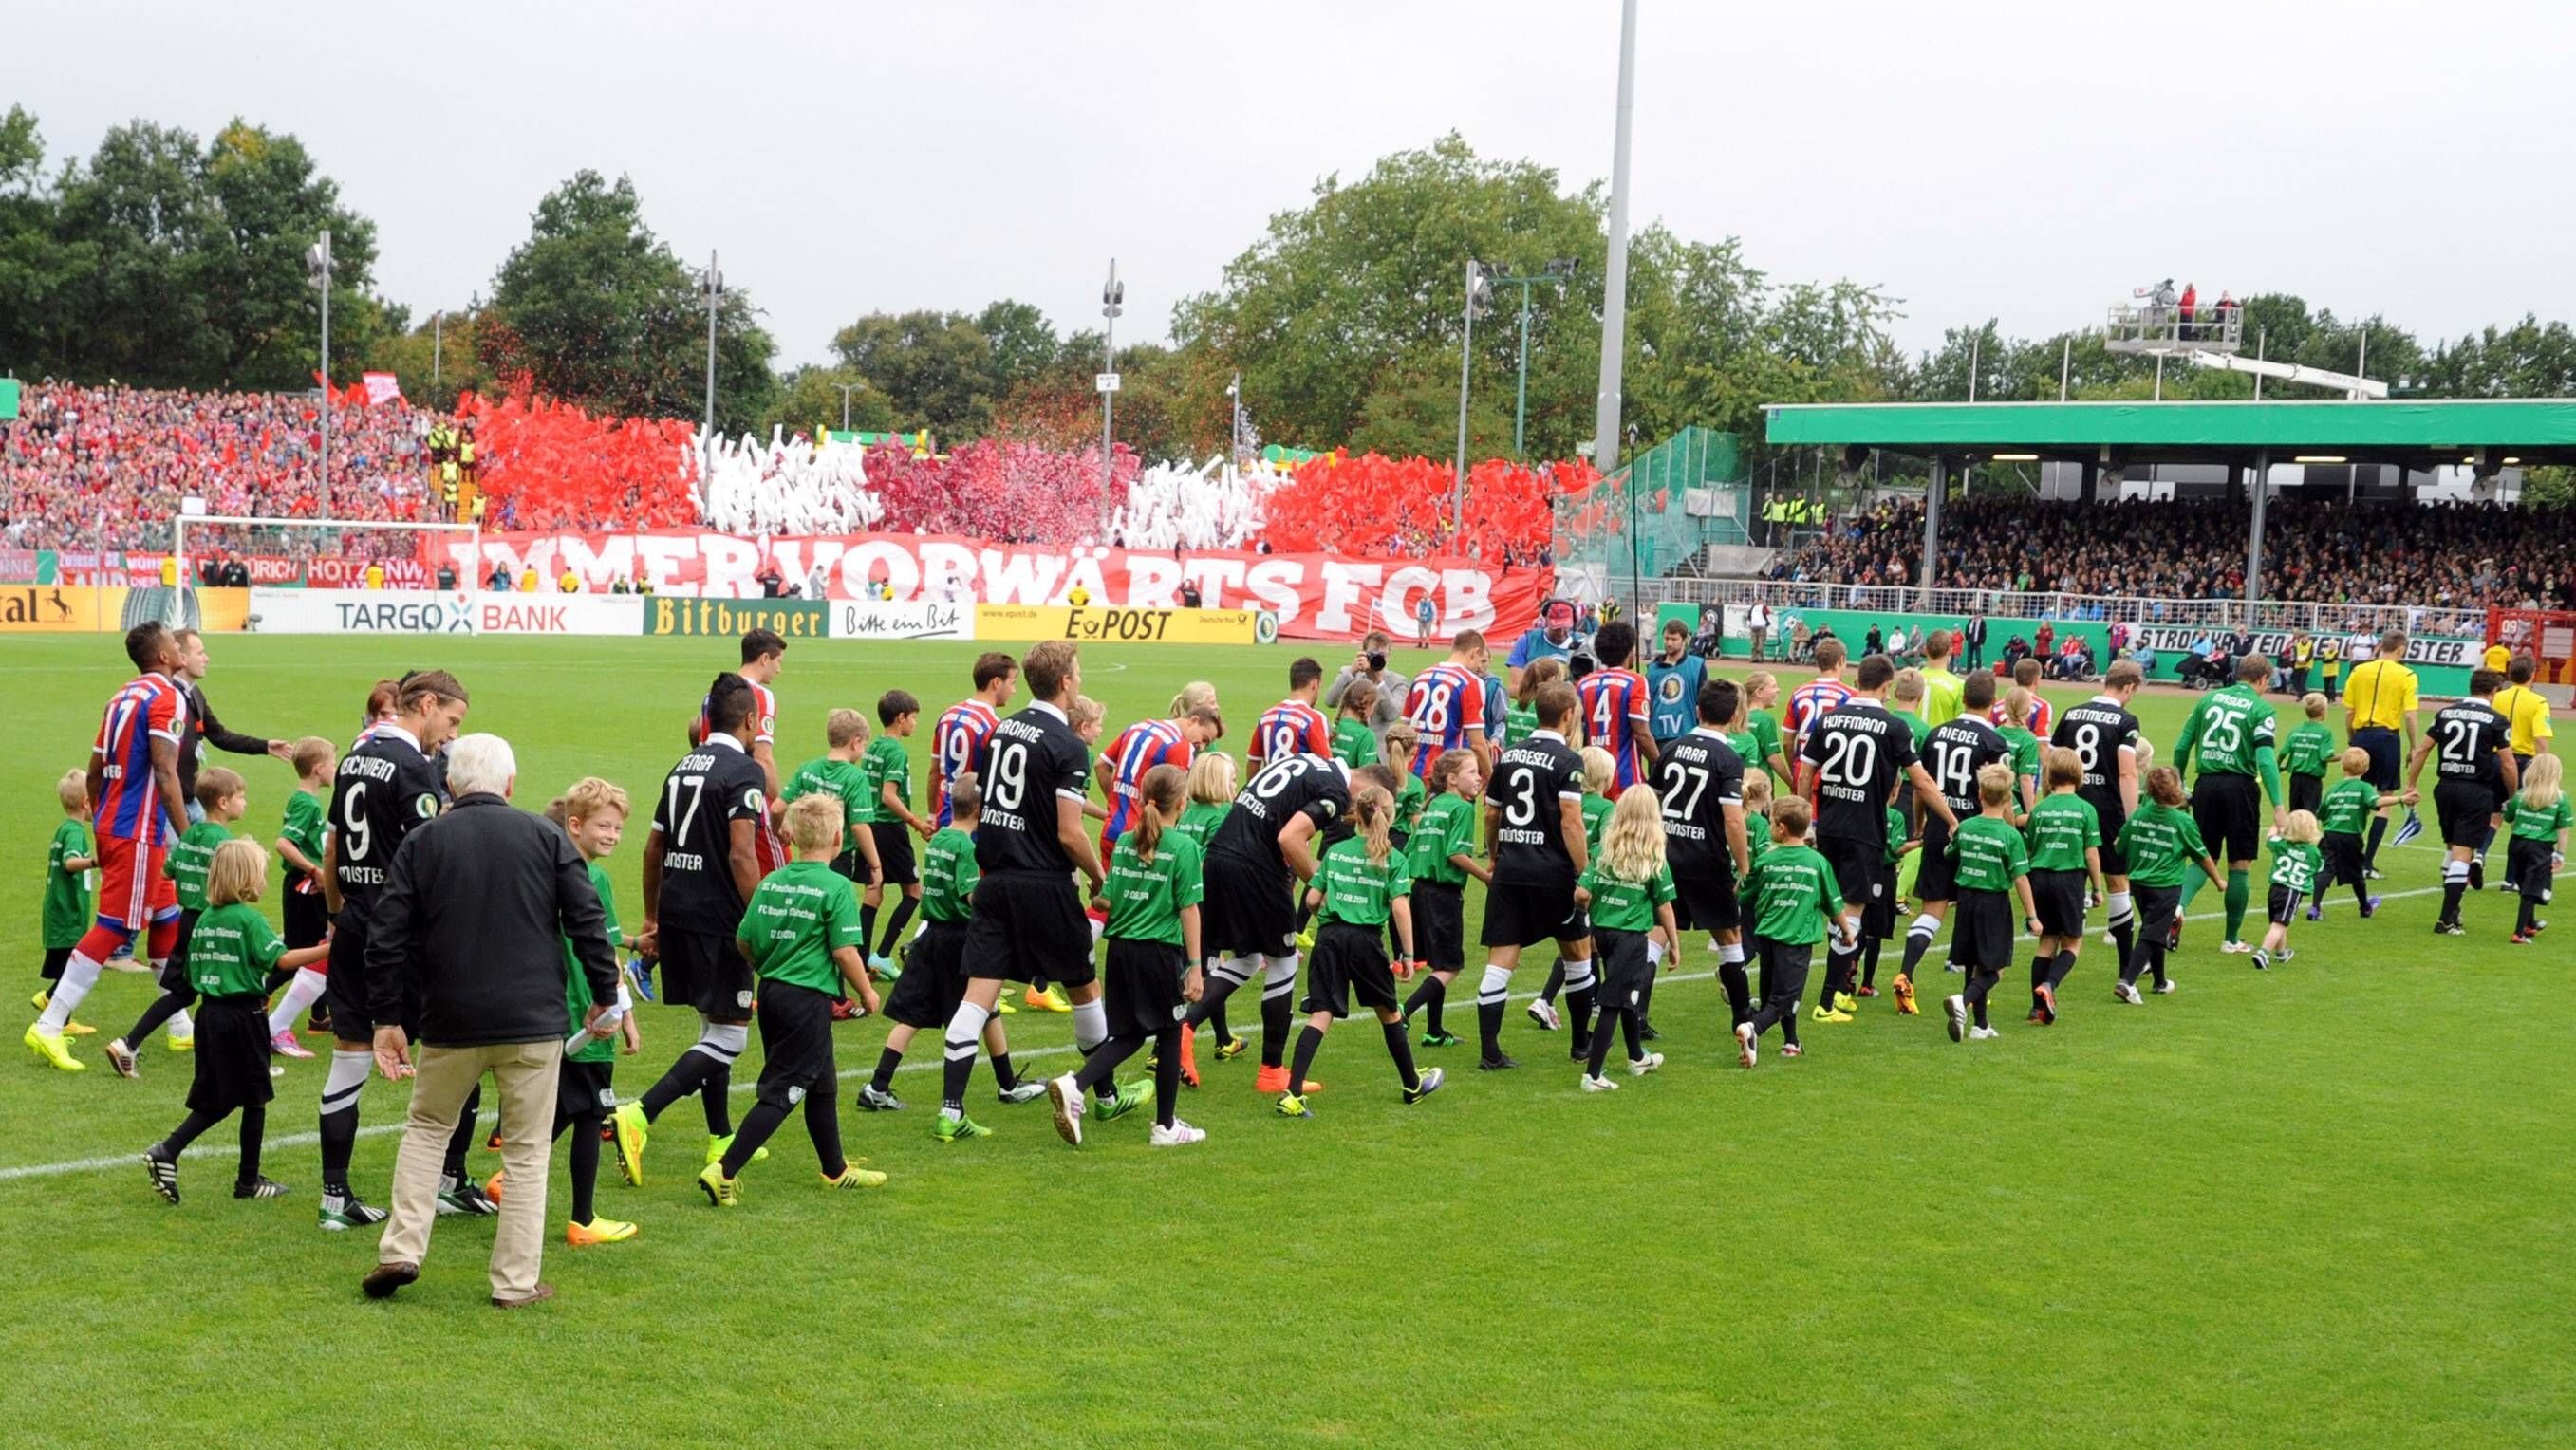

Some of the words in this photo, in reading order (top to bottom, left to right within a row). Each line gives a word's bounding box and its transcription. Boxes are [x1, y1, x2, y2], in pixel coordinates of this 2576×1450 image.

[450, 533, 759, 600] IMMER
[773, 541, 1303, 628] VORWÄRTS
[1316, 561, 1497, 638] FCB
[336, 604, 443, 630] TARGO
[483, 605, 568, 630] BANK
[656, 598, 821, 636] Bitburger
[846, 606, 886, 635] Bitte
[892, 613, 922, 630] ein
[926, 604, 960, 627] Bit
[1410, 681, 1450, 732] 28
[1593, 688, 1612, 734] 4
[1659, 713, 1683, 734] TV
[1823, 714, 1887, 734] HOFFMANN
[2065, 709, 2121, 725] HEITMEIER
[996, 718, 1044, 744] KROHNE
[1263, 725, 1294, 766] 18
[1938, 725, 1979, 746] RIEDEL
[2075, 723, 2100, 771] 8
[2202, 705, 2247, 753] 25
[2443, 719, 2479, 761] 21
[940, 723, 969, 781] 19
[985, 738, 1027, 810] 19
[1117, 729, 1154, 782] 11
[1675, 745, 1708, 763] KARA
[1821, 731, 1876, 787] 20
[1933, 740, 1972, 796] 14
[668, 775, 705, 847] 17
[1506, 768, 1535, 826] 3
[1663, 762, 1708, 821] 27
[345, 782, 370, 861] 9
[980, 806, 1025, 831] ÜNSTER
[664, 848, 703, 871] ÜNSTER
[2272, 855, 2310, 886] 25
